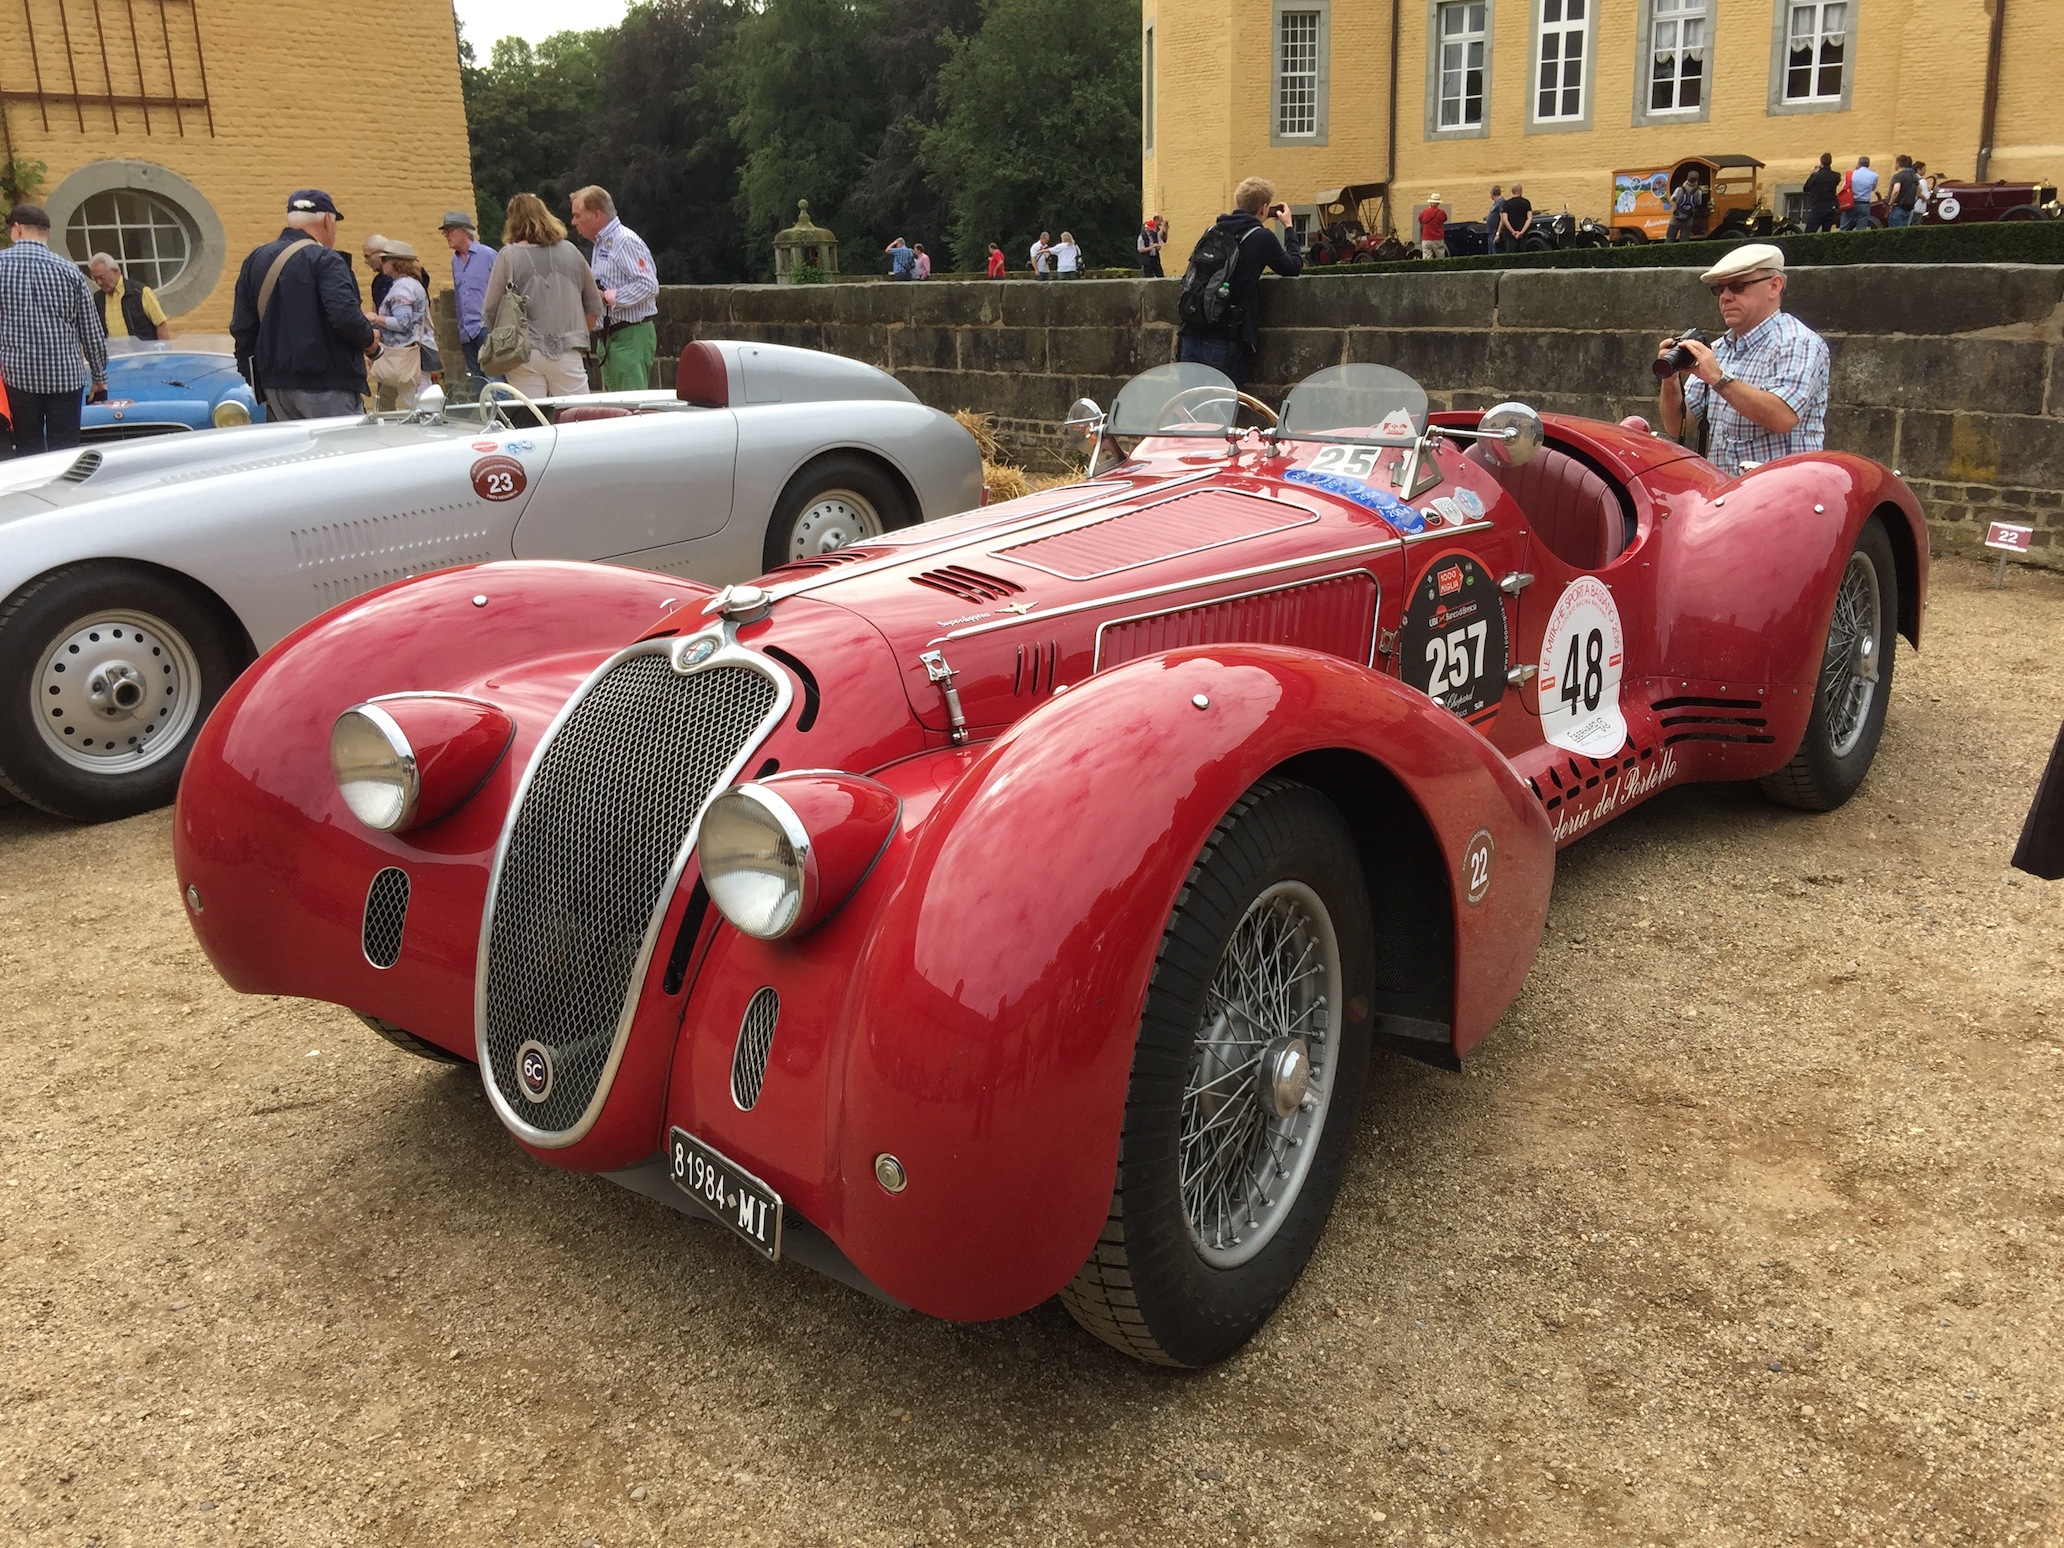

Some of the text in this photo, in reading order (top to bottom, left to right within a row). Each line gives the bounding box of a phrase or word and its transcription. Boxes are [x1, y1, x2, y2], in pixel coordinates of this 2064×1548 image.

[1311, 447, 1379, 476] 25
[487, 472, 514, 494] 23
[1998, 529, 2019, 544] 22
[1440, 570, 1457, 582] 1000
[1441, 580, 1459, 594] MIGLIA
[1585, 583, 1591, 596] A
[1565, 584, 1584, 609] SPORT
[1591, 584, 1615, 623] BASSANO
[1545, 604, 1566, 654] MITICHE
[1425, 619, 1487, 697] 257
[1543, 657, 1551, 672] LE
[1561, 628, 1602, 716] 48
[1593, 777, 1621, 821] del
[1620, 748, 1677, 805] Portello
[1471, 846, 1488, 891] 22
[524, 1058, 543, 1081] 6C
[674, 1142, 768, 1242] 81984 MI
